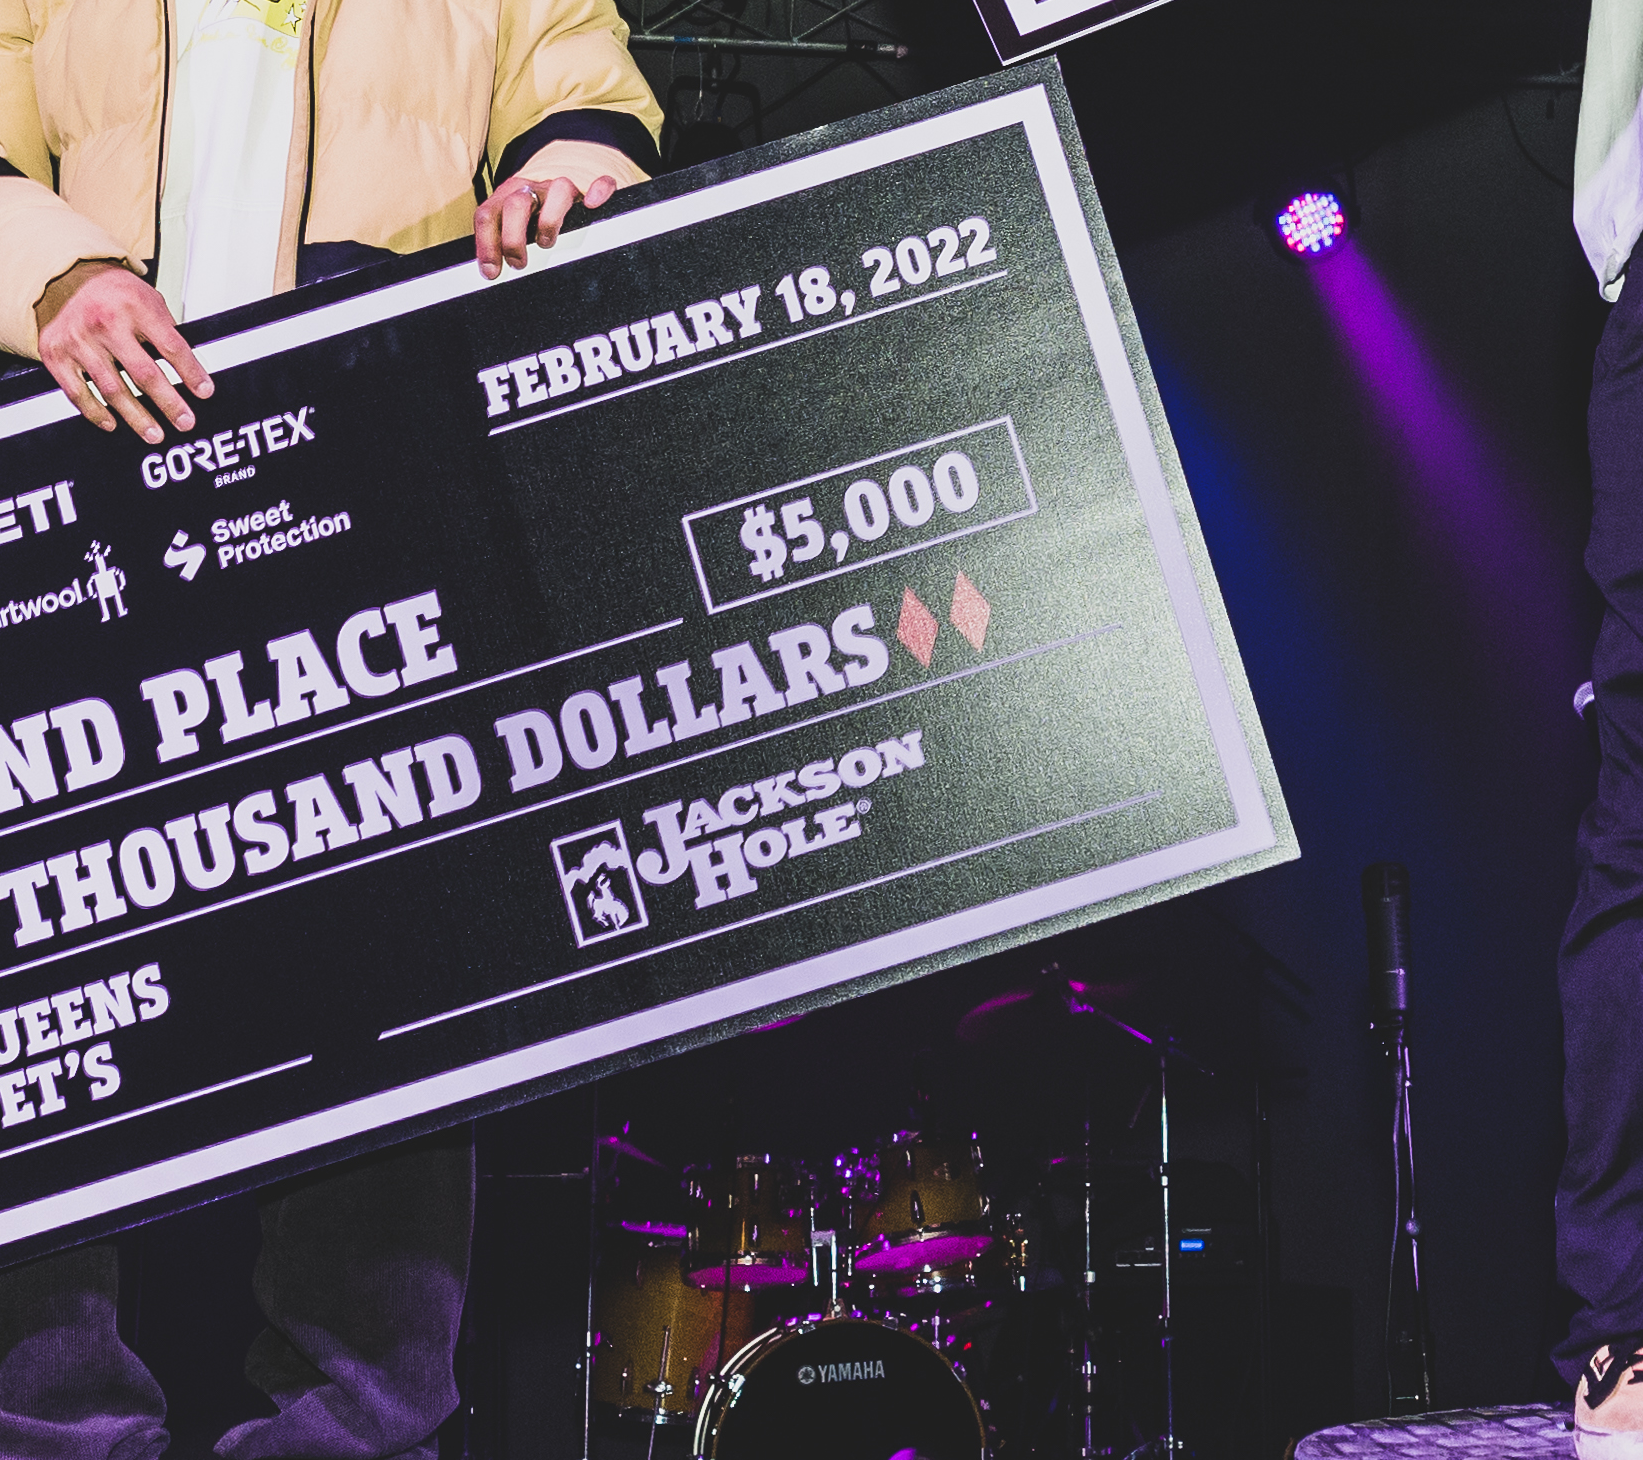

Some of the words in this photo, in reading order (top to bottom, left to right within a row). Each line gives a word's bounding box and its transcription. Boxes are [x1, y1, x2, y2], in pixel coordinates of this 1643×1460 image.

[478, 284, 762, 418] FEBRUARY
[775, 266, 855, 322] 18,
[862, 216, 997, 298] 2022
[142, 406, 314, 488] GORE-TEX
[215, 467, 255, 488] BRAND
[211, 500, 293, 542] Sweet
[218, 512, 350, 569] Protection
[740, 450, 980, 582] $5,000
[140, 590, 457, 762] PLACE
[495, 601, 889, 792] DOLLARS
[637, 729, 927, 884] JACKSON
[818, 1360, 886, 1383] YAMAHA
